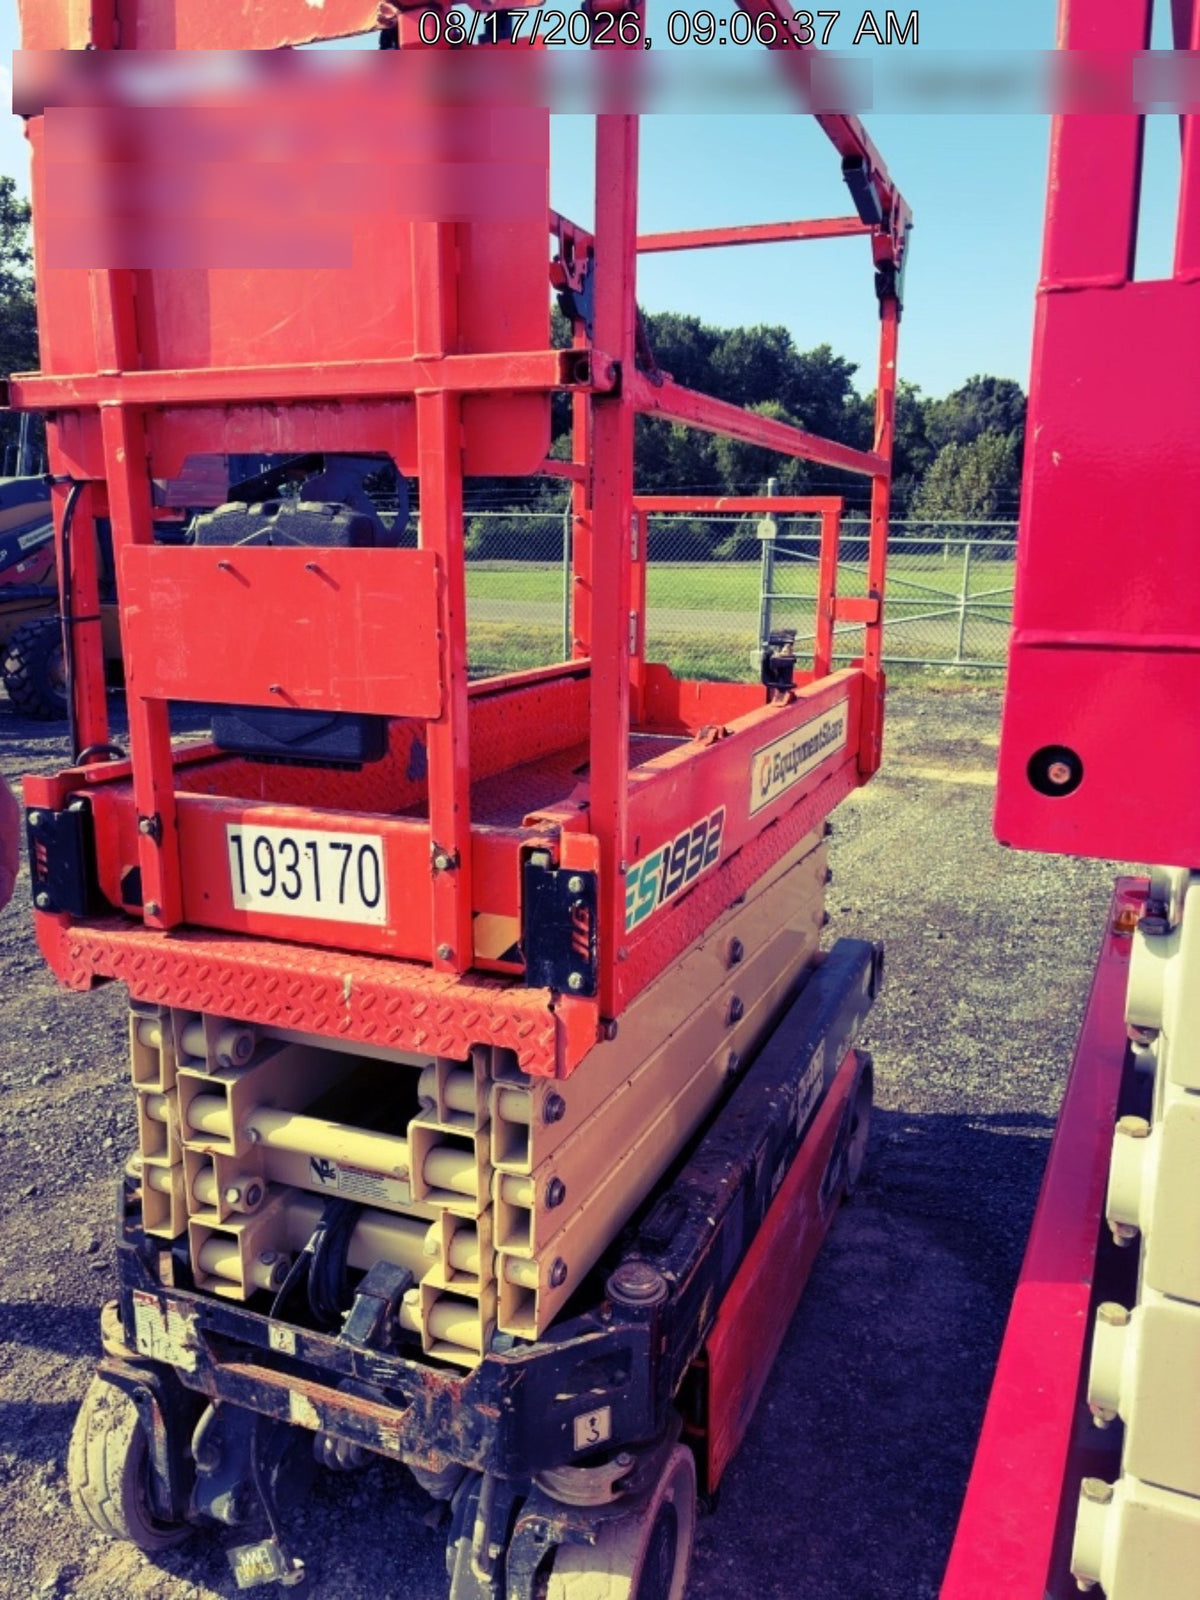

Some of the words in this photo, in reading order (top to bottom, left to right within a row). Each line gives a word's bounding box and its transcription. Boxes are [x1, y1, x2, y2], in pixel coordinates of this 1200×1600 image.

[773, 718, 843, 784] EquipmentShare
[231, 835, 380, 908] 193170
[625, 808, 725, 930] ES1932
[571, 902, 590, 963] JLG
